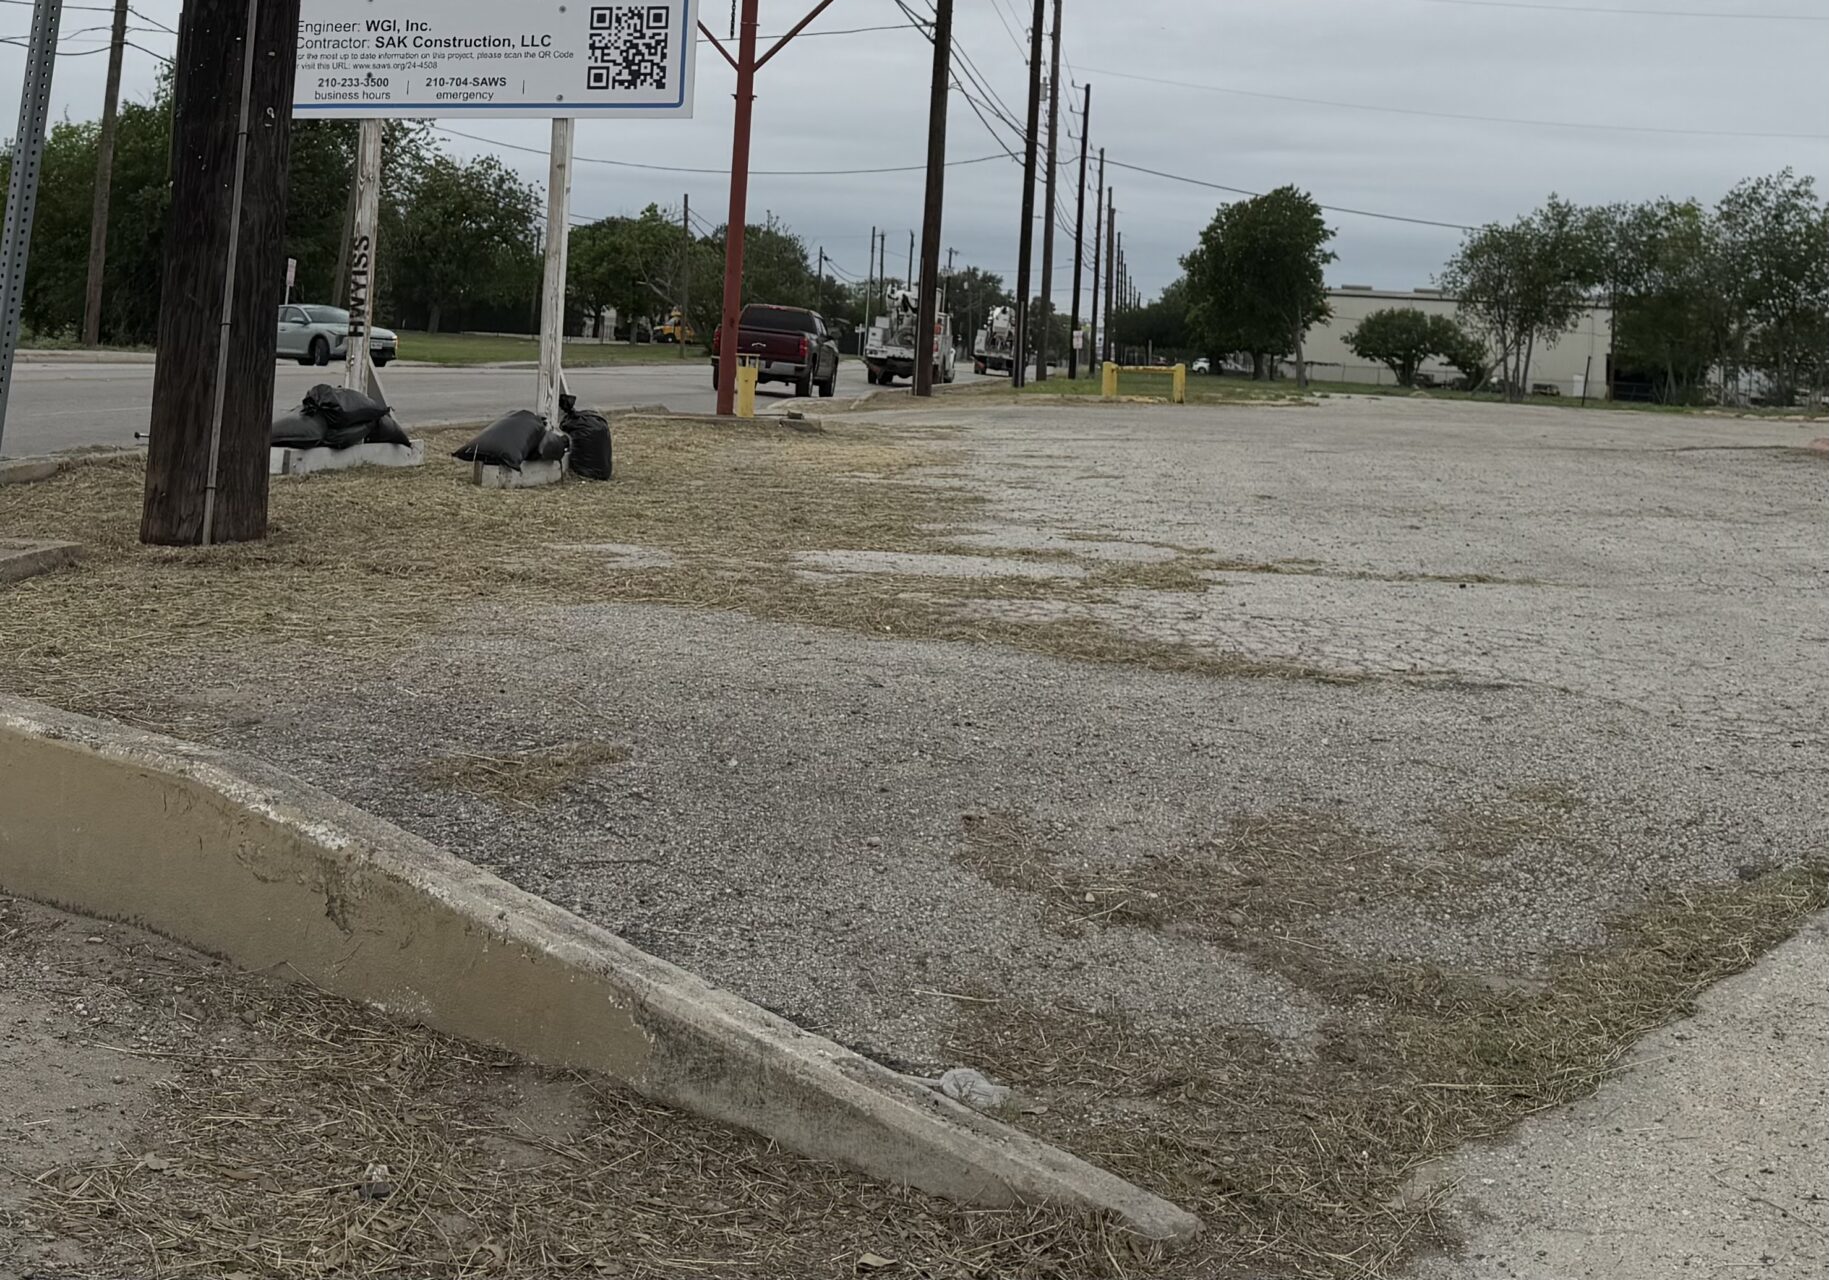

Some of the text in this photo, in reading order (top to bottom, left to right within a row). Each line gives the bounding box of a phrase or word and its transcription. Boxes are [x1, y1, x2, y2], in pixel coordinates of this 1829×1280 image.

[298, 19, 432, 35] Engineer: WGI, Inc.
[298, 34, 552, 49] Contractor: SAK Construction, LLC
[320, 52, 338, 60] most
[351, 52, 359, 60] to
[360, 51, 377, 60] date
[378, 51, 420, 60] information
[421, 52, 431, 60] on
[477, 51, 502, 60] please
[524, 51, 536, 59] the
[538, 51, 551, 59] QR
[553, 50, 574, 59] Code
[301, 62, 316, 70] visit
[317, 62, 330, 70] this
[318, 77, 389, 88] 210-233-3500
[425, 76, 507, 87] 210-704-SAWS
[314, 89, 391, 100] business hours
[436, 90, 494, 101] emergency
